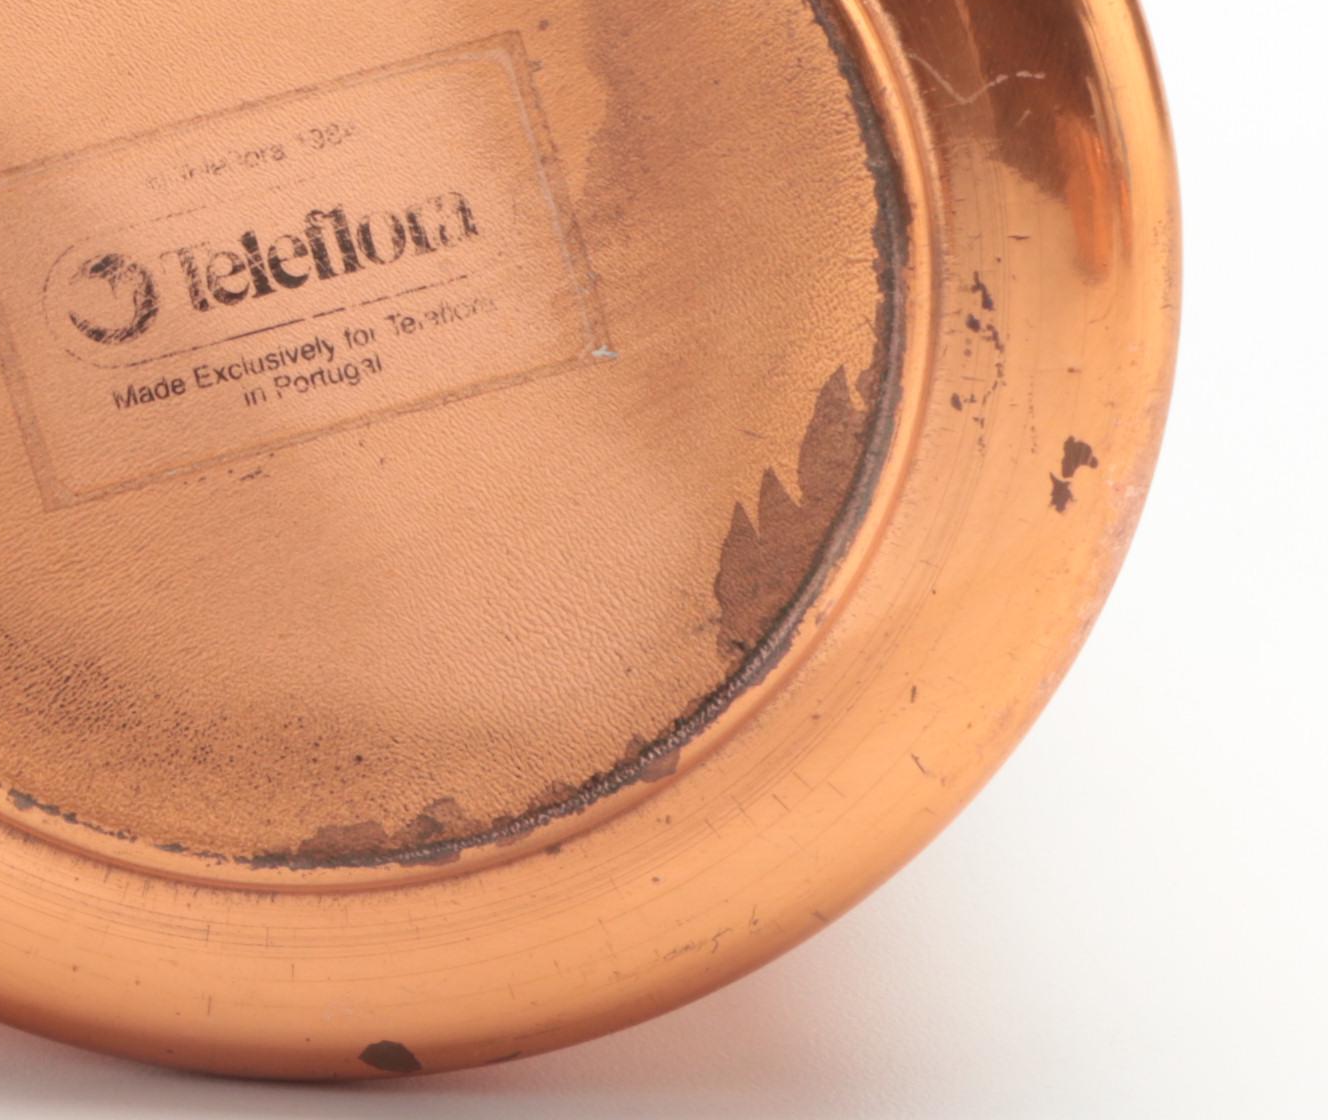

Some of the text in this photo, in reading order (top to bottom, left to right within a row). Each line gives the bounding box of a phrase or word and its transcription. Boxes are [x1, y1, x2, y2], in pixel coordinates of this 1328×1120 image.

[159, 189, 480, 313] Teleflora
[112, 377, 187, 411] Made
[194, 335, 337, 389] Exclusively
[243, 354, 384, 408] in Portugal
